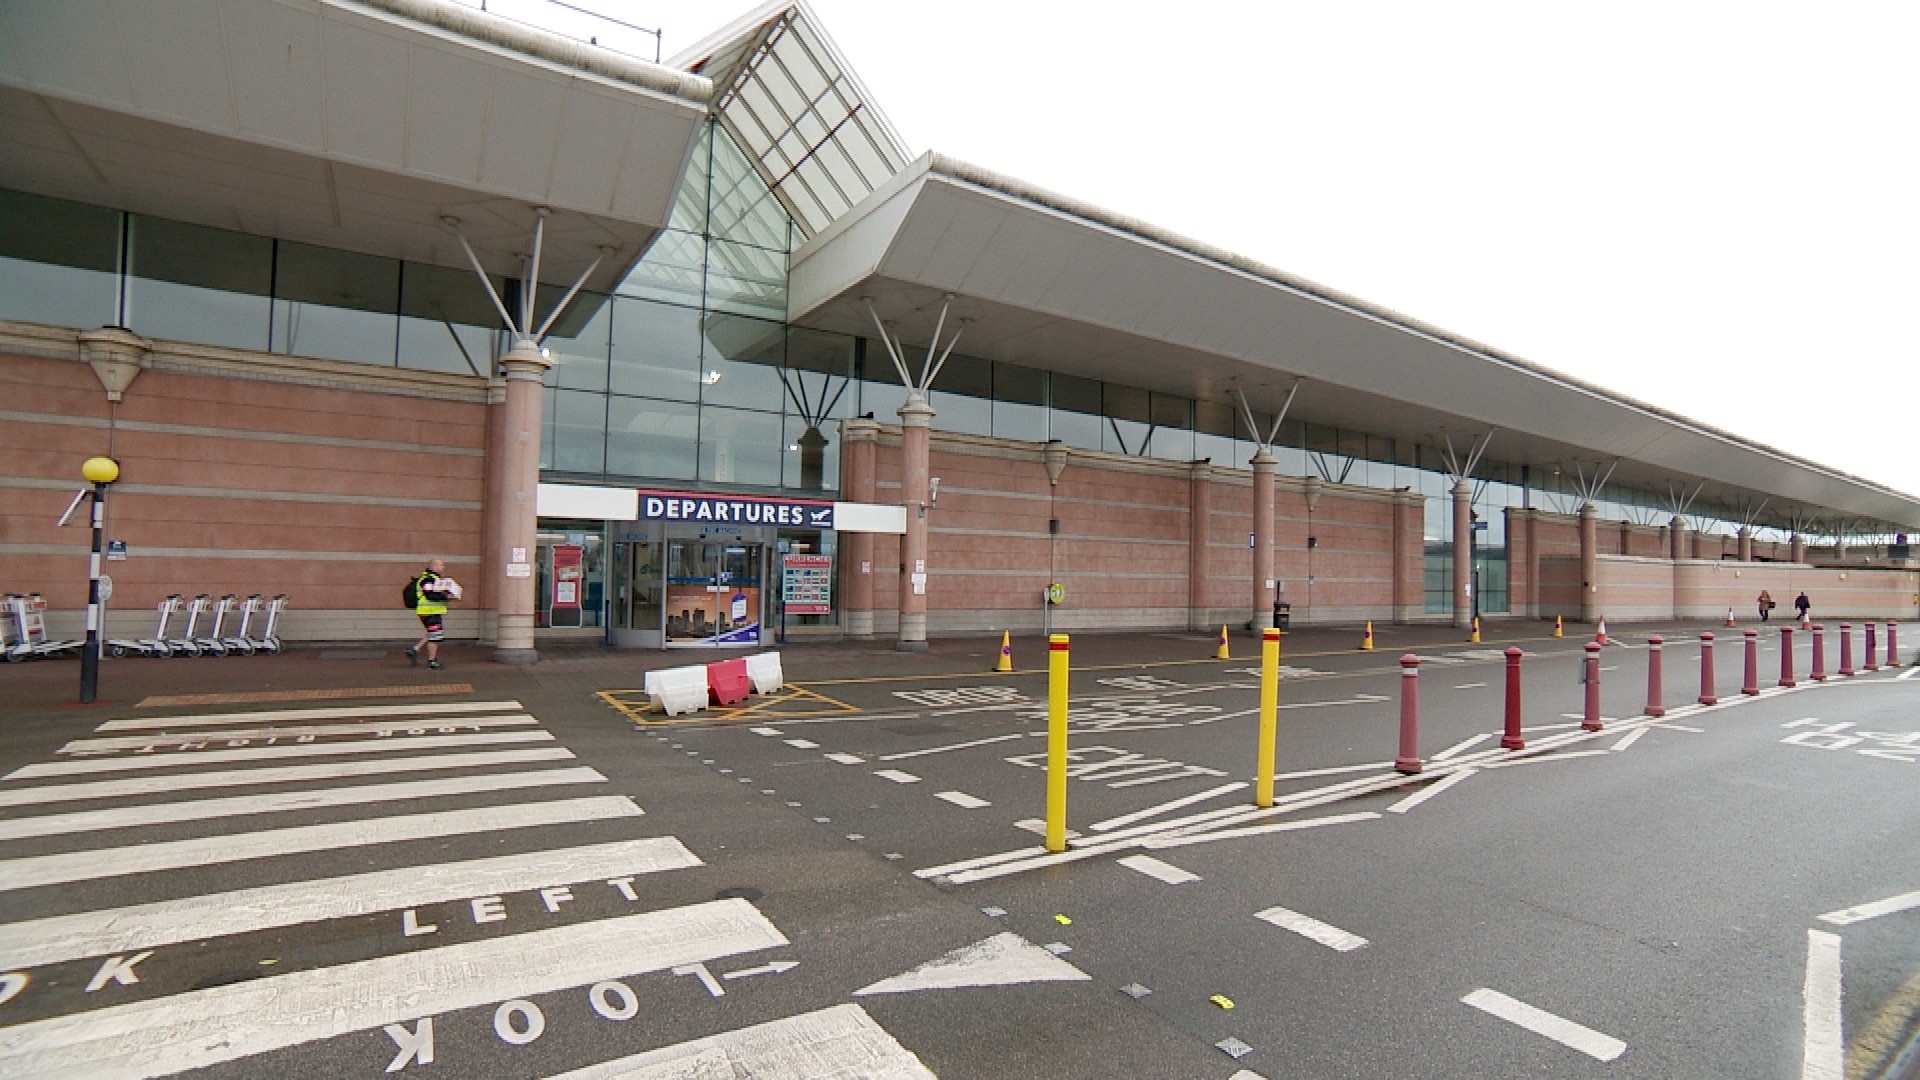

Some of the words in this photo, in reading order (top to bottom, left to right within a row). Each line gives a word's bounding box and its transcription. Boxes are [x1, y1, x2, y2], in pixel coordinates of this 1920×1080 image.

[647, 497, 803, 525] DEPARTURES
[1003, 745, 1229, 789] EXIT
[402, 876, 641, 937] LEFT
[384, 963, 729, 1073] LOOK
